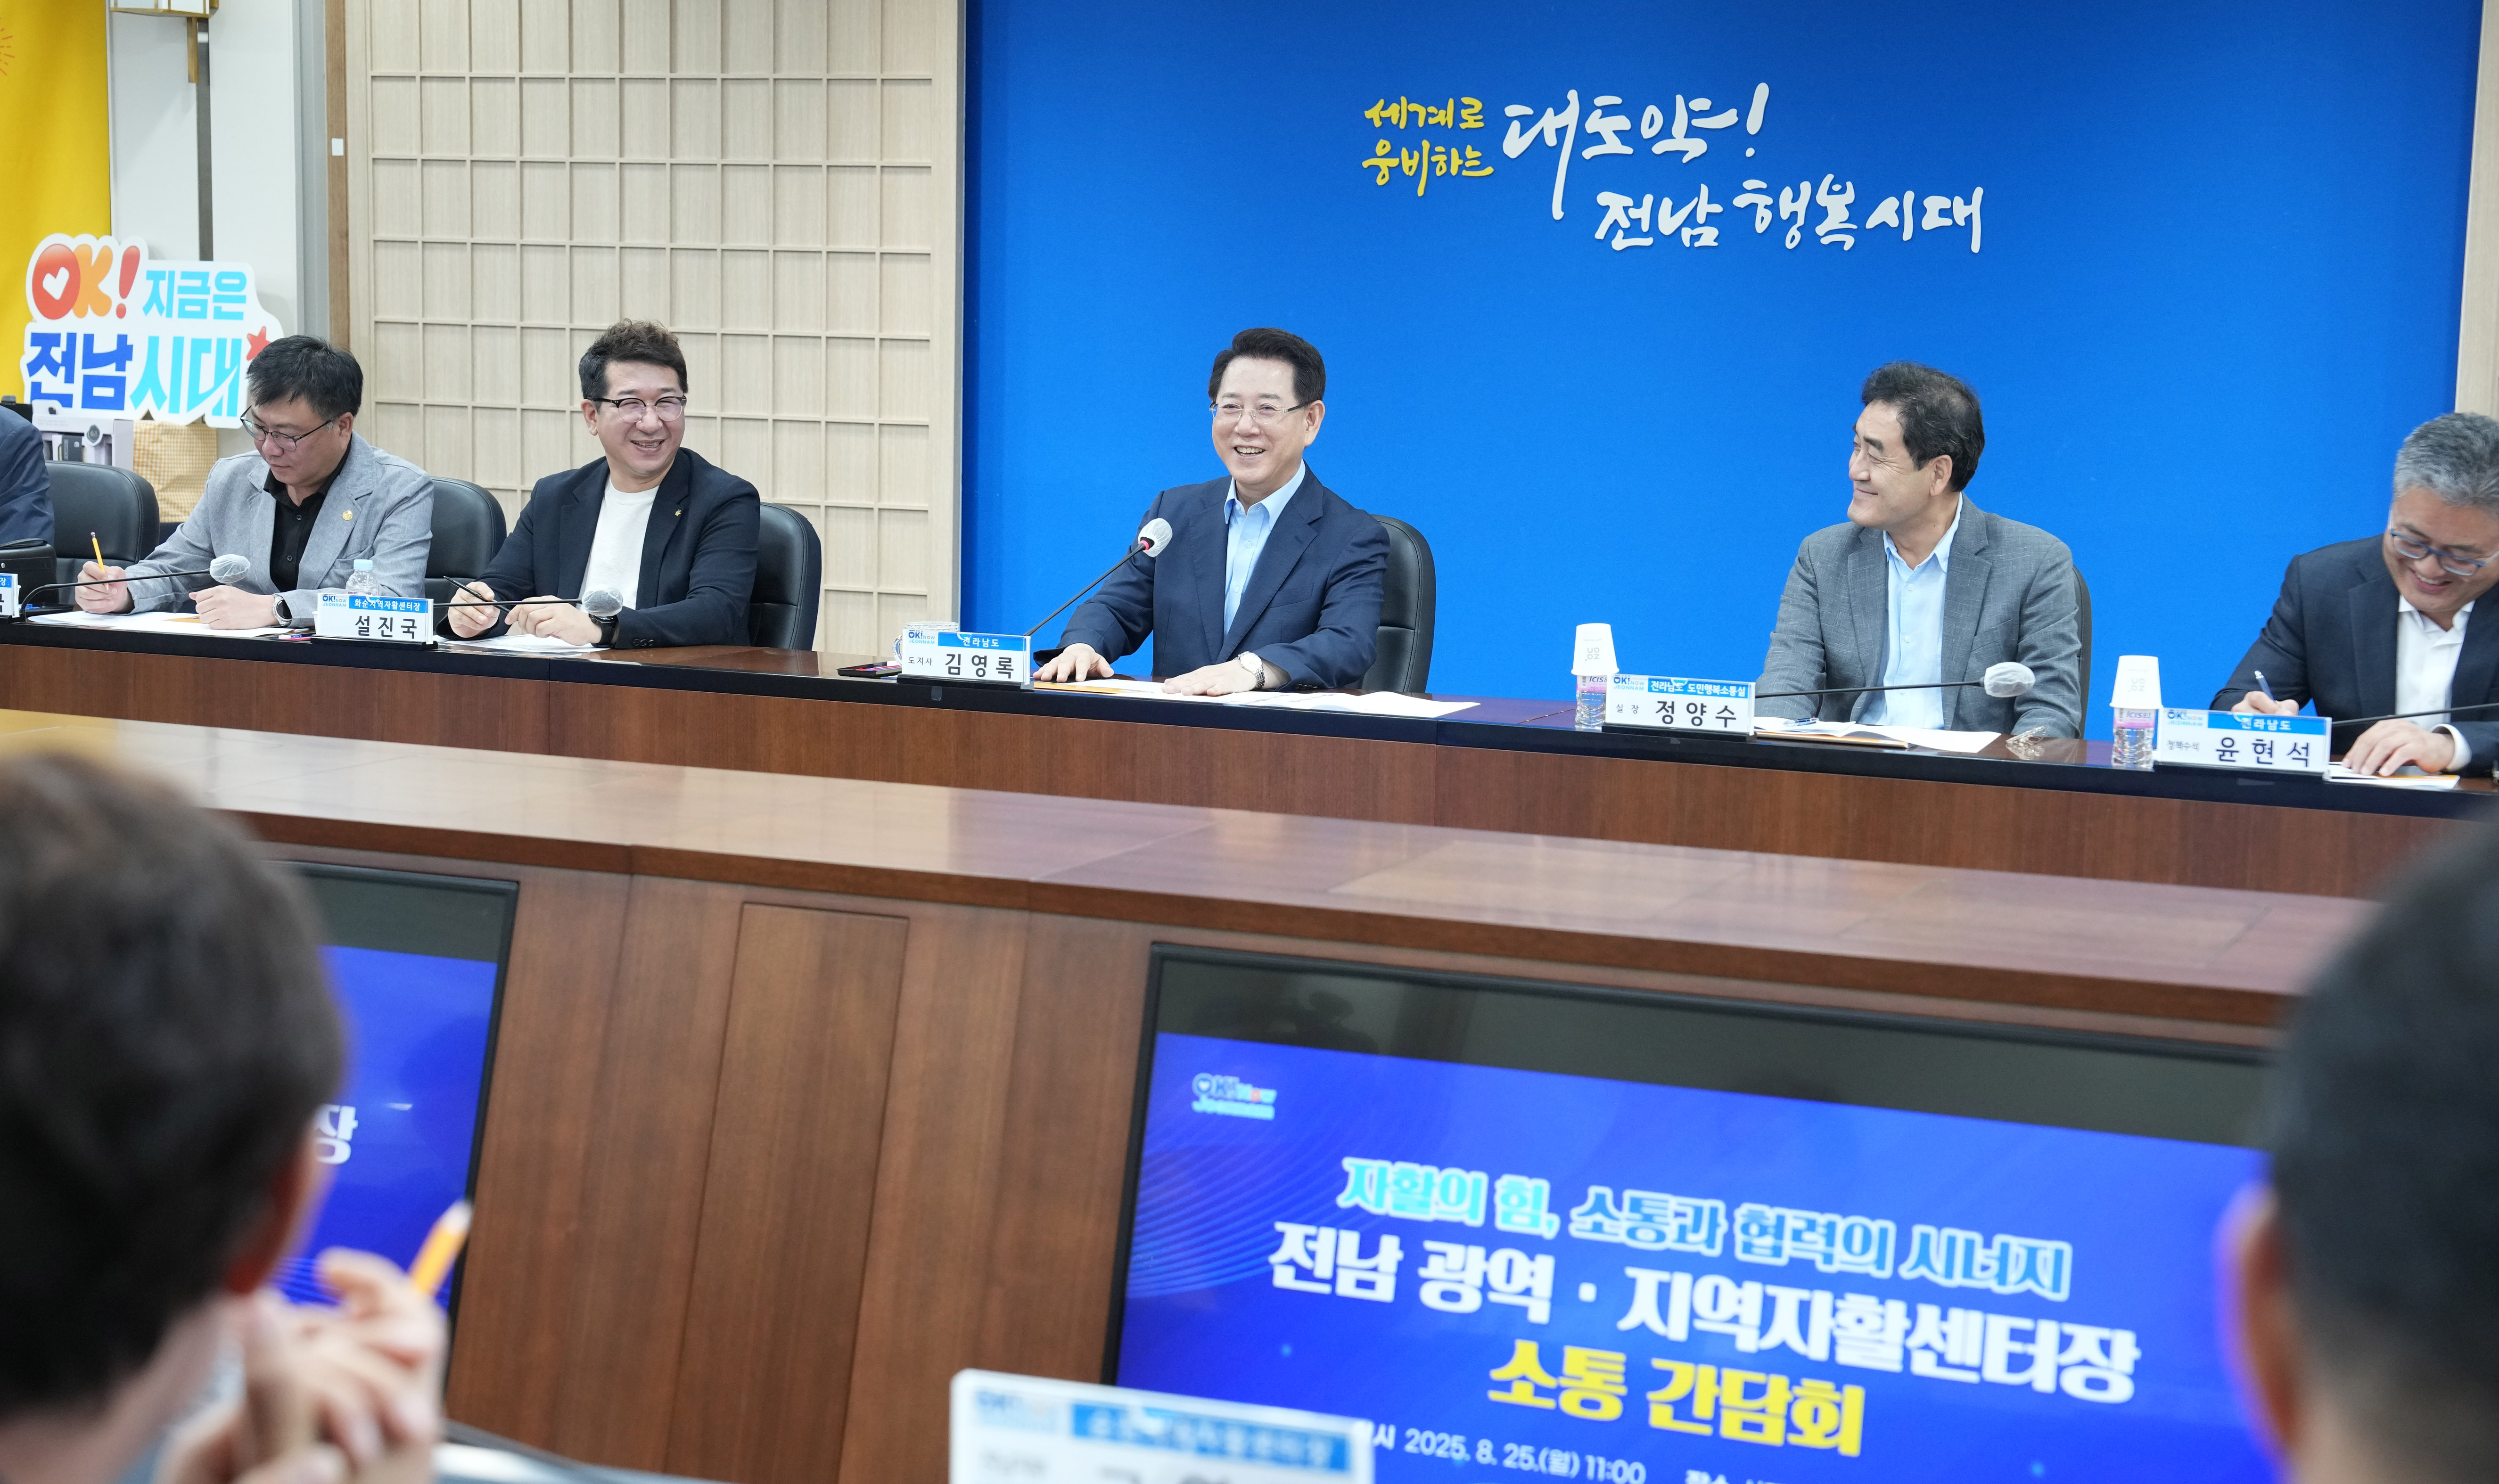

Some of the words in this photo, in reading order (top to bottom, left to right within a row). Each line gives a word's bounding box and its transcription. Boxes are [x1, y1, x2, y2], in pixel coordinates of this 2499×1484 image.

[1365, 96, 1485, 129] 세계로
[1362, 139, 1494, 197] 웅비하는
[1503, 82, 1769, 220] 대도약!
[1595, 183, 1723, 251] 전남
[32, 244, 140, 320] OK!
[142, 270, 247, 320] 지금은
[355, 615, 417, 639] 설진국
[962, 637, 999, 648] 전라남도
[908, 656, 933, 666] 도지사
[945, 654, 1014, 679] 김영록
[1687, 684, 1746, 697] 도민행복소통실
[1655, 701, 1736, 728] 정양수
[1337, 1157, 1488, 1227] 자활의
[1495, 1174, 1561, 1239] 힘,
[1569, 1186, 1728, 1258] 소통과
[1734, 1203, 1896, 1278] 협력의
[1899, 1224, 2073, 1302] 시너지
[1268, 1221, 1403, 1303] 전남
[1418, 1239, 1555, 1324] 광역
[1617, 1266, 2142, 1404] 지역자활센터장
[1488, 1339, 1628, 1421] 소통
[1646, 1358, 1865, 1457] 간담회
[1404, 1427, 1471, 1461] 2025.
[1475, 1438, 1498, 1466] 8.
[1586, 1454, 1646, 1484] 11:00
